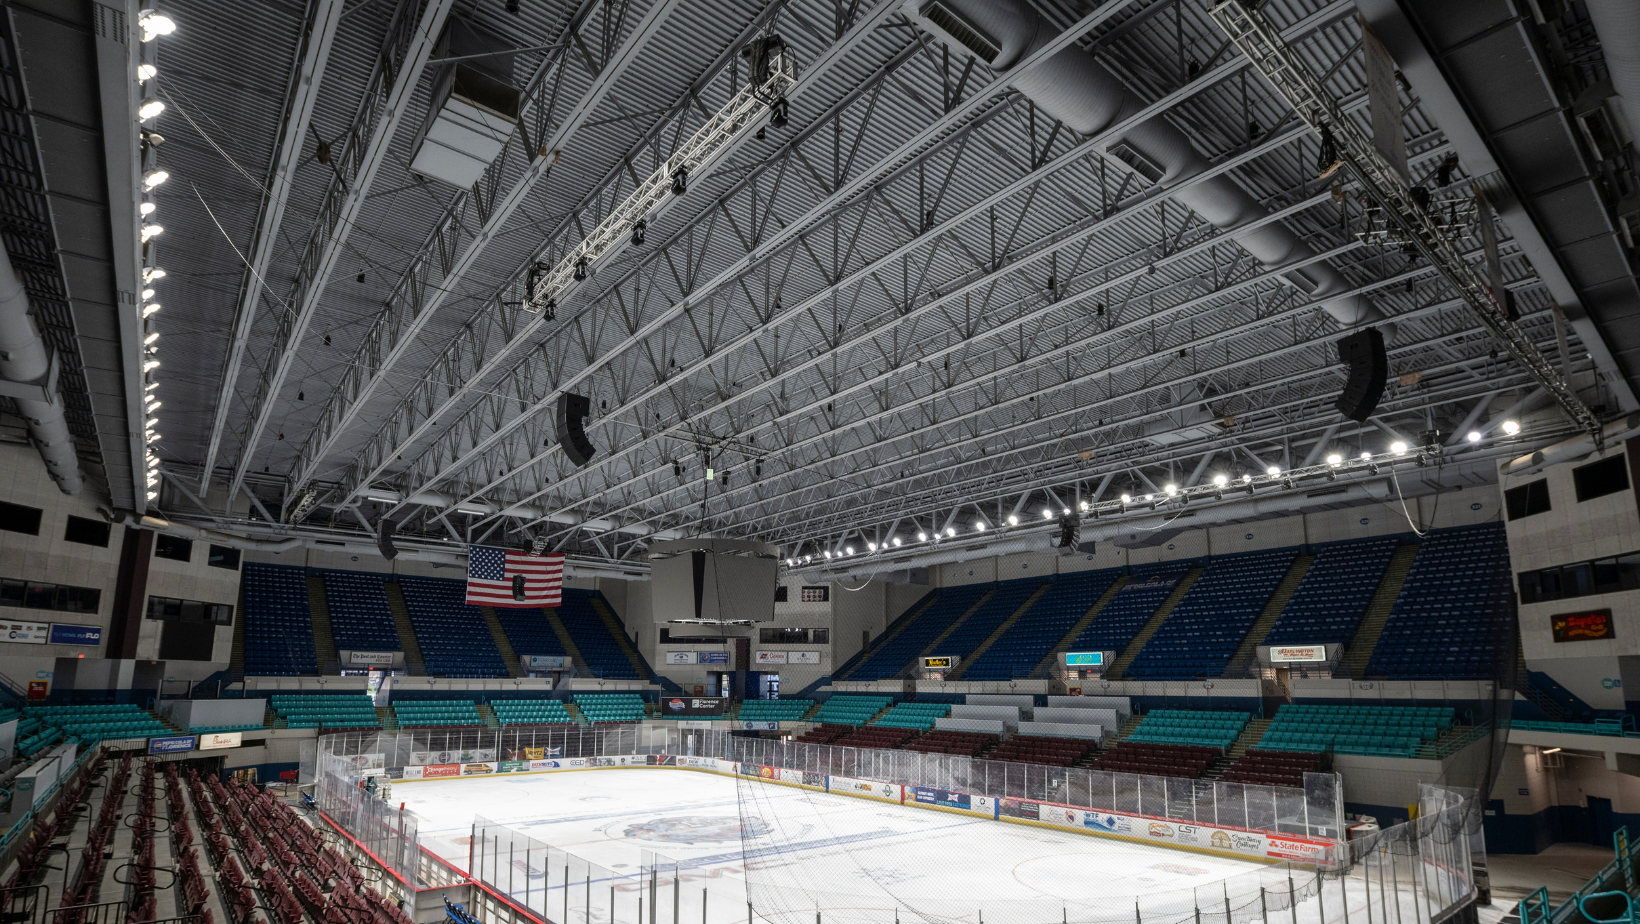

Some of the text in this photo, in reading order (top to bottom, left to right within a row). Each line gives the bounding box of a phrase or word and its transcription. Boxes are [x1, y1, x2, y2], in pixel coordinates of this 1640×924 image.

[1178, 825, 1197, 834] CST
[1232, 834, 1261, 845] Sanctuary
[1280, 841, 1299, 851] State
[1300, 845, 1320, 854] Farm
